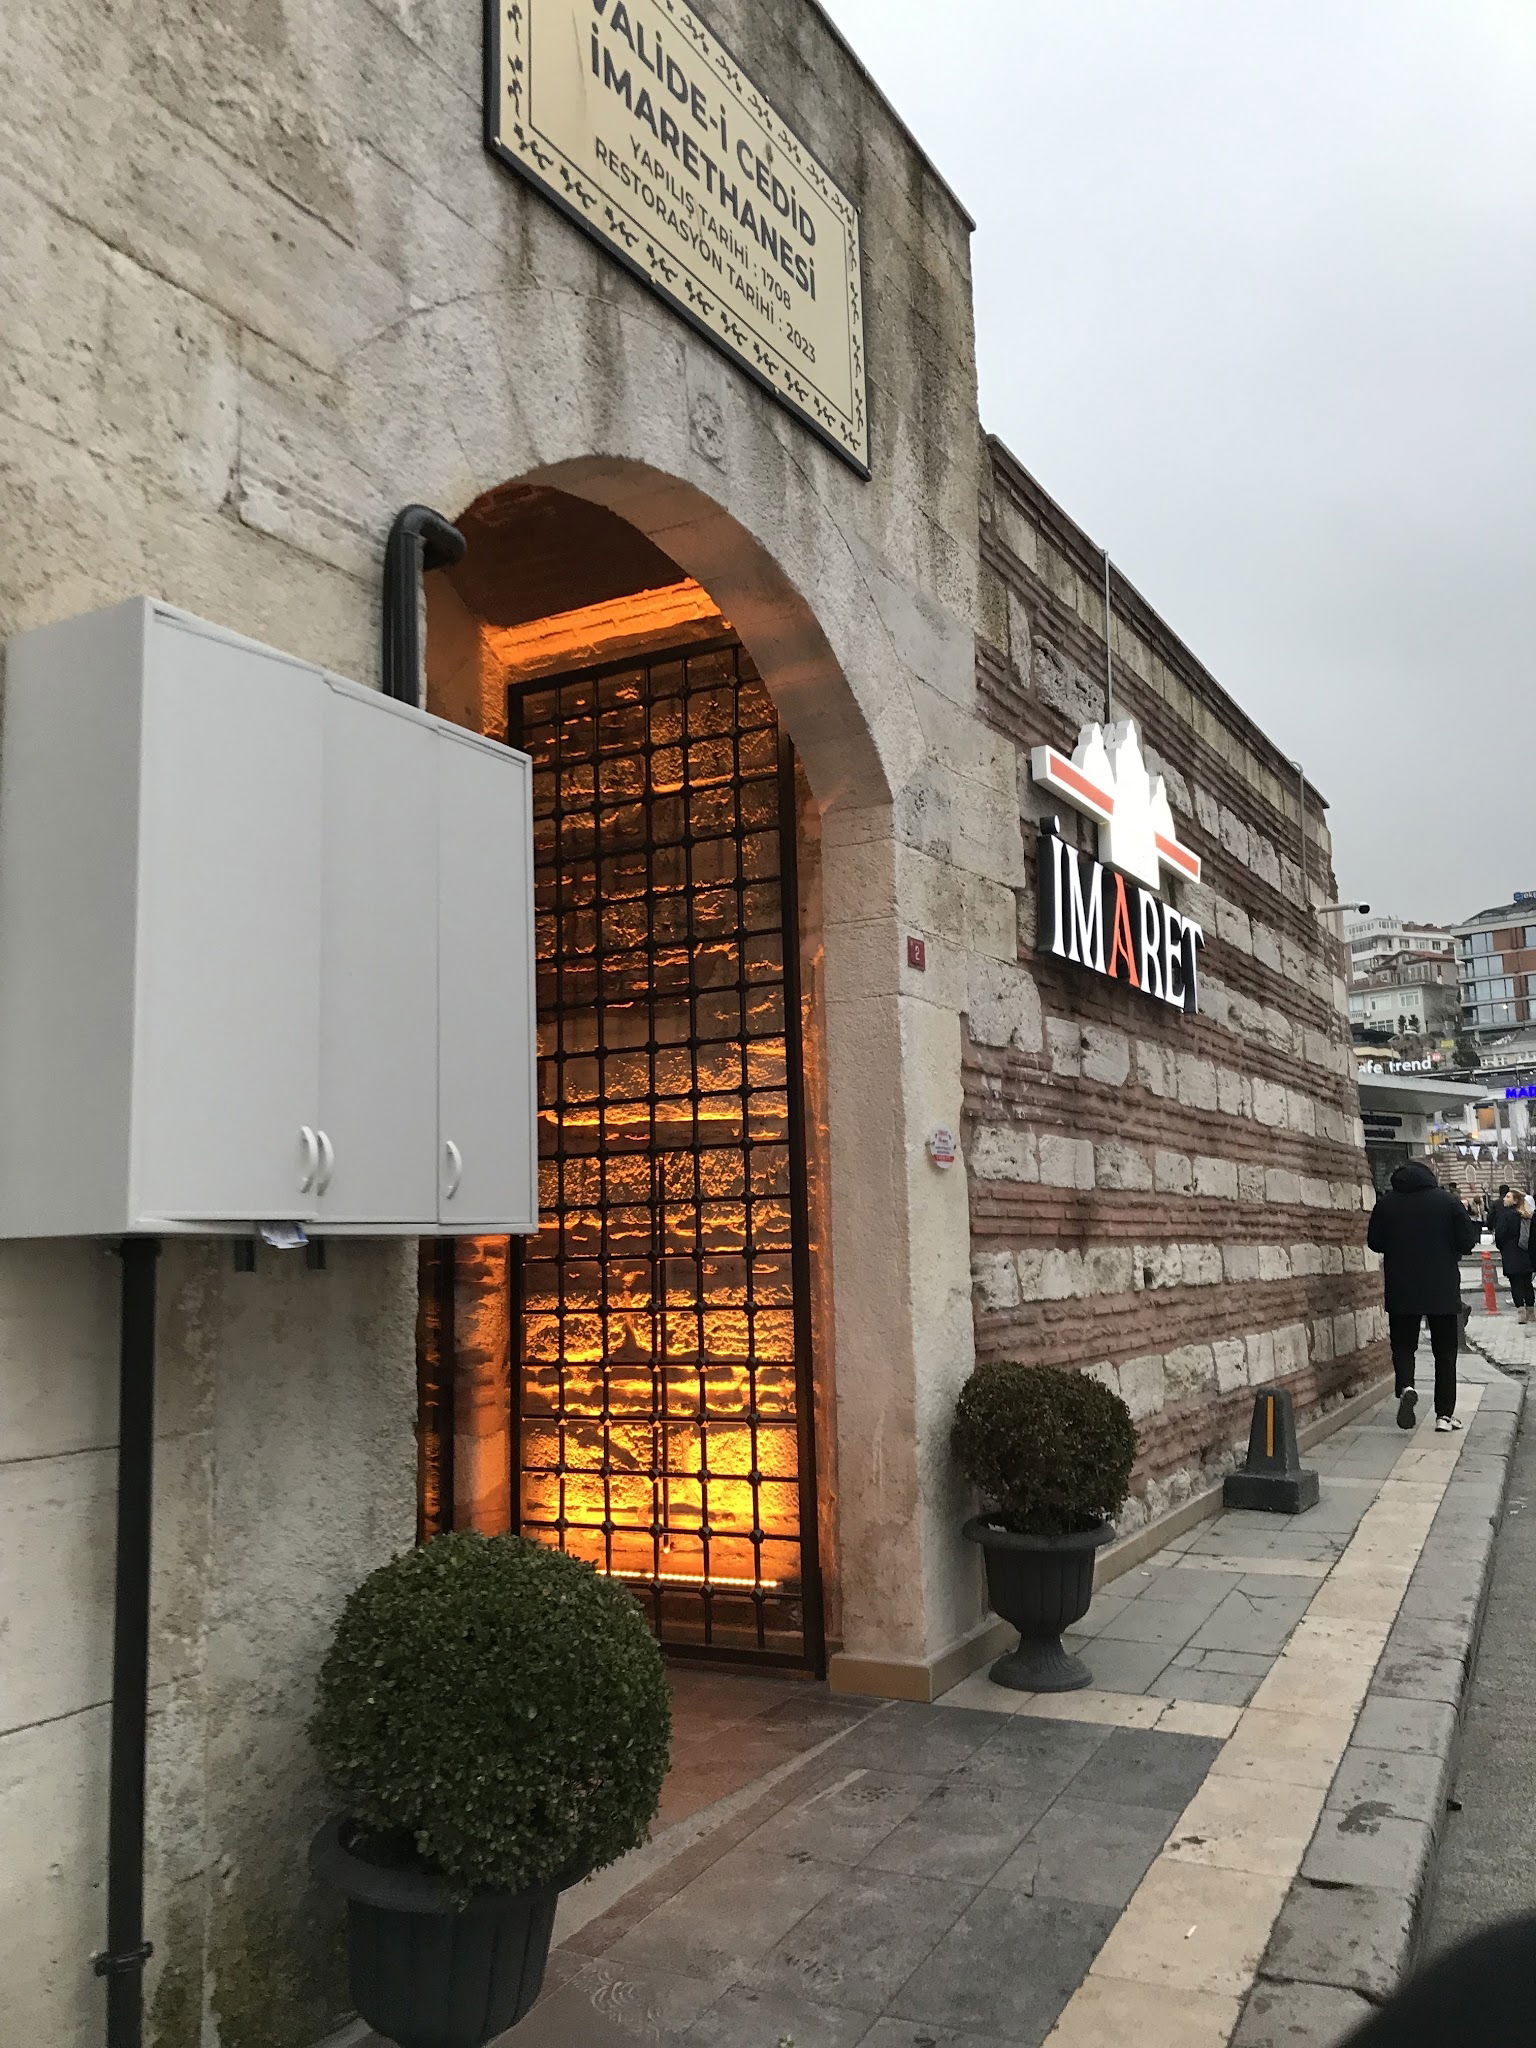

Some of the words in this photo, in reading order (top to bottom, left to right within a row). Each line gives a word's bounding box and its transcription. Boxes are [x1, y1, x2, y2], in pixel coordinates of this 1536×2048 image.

[591, 21, 816, 302] İMARETHANESİ
[630, 134, 695, 219] YAPILIŞ
[699, 203, 749, 270] TARİHİ
[762, 267, 791, 310] 1708
[737, 139, 816, 247] CEDİD
[596, 136, 723, 275] RESTORASYON
[726, 263, 775, 325] TARİHİ
[786, 322, 816, 364] 2023
[914, 945, 921, 961] 2
[1044, 813, 1206, 1014] İMARET
[1389, 1055, 1432, 1073] trend
